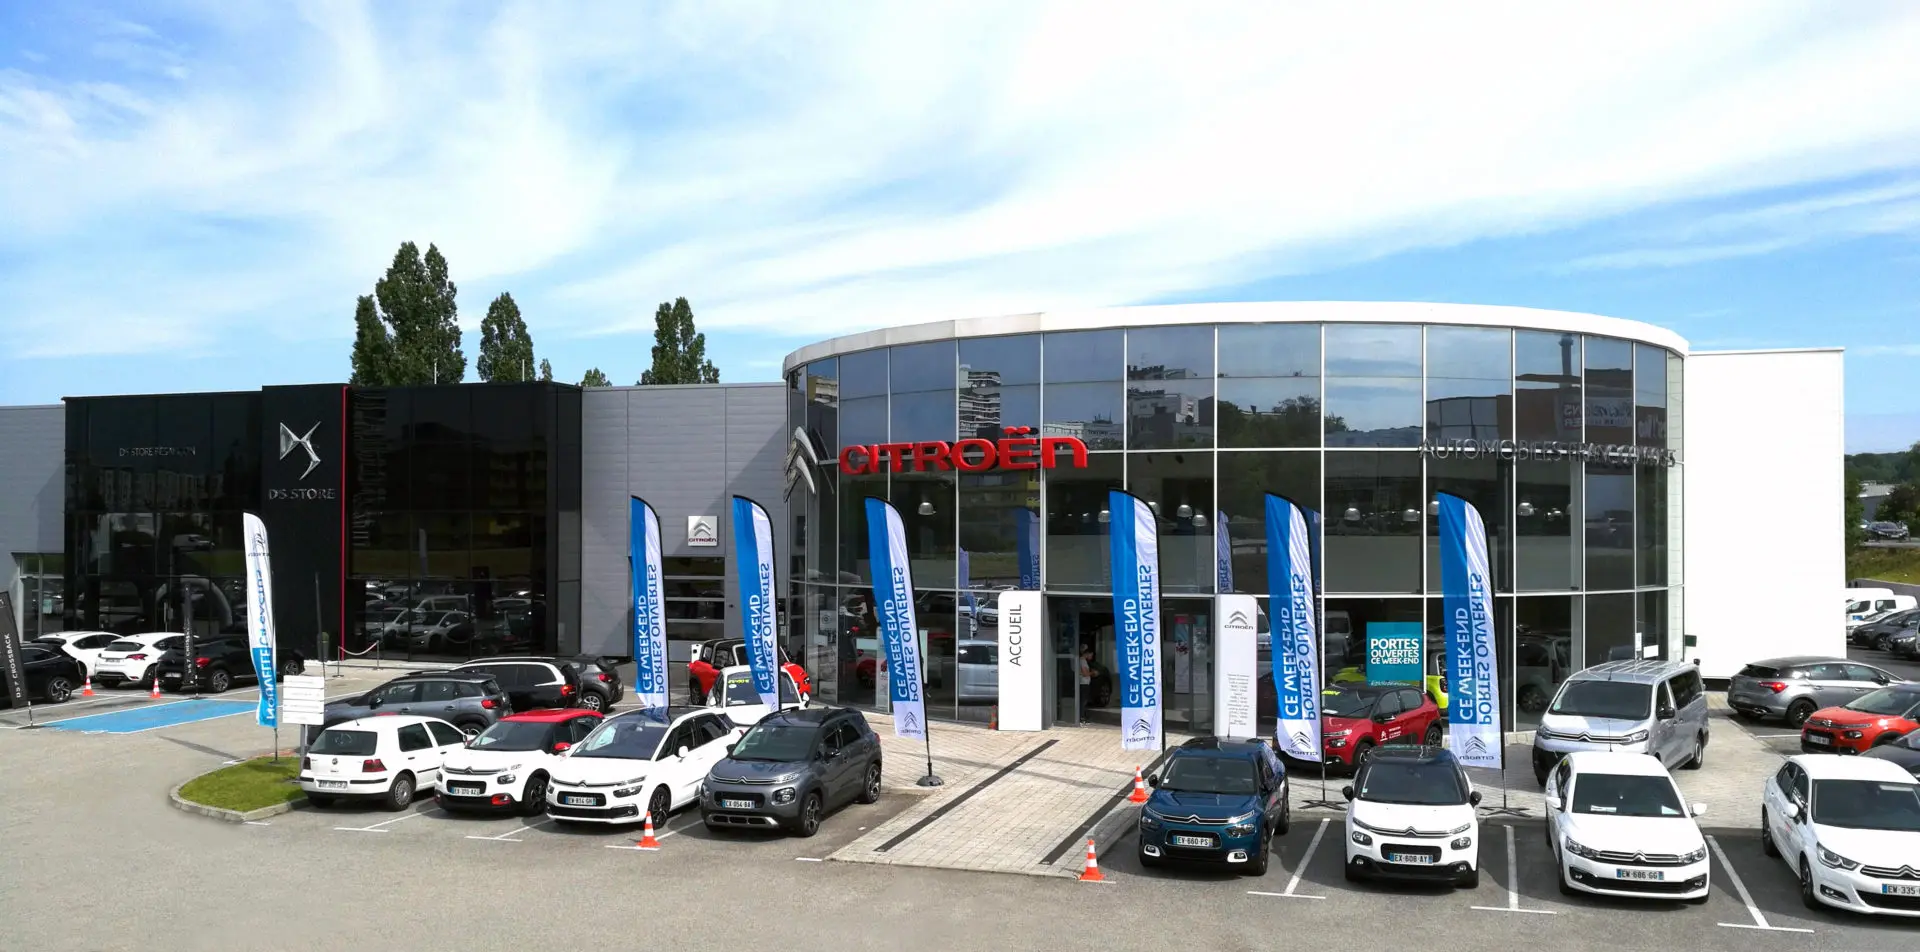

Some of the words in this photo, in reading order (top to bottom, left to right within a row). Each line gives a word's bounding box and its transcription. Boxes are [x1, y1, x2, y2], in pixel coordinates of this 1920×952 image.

[838, 425, 1089, 475] CITROËN
[1419, 438, 1561, 460] AUTOMOBILES
[269, 488, 287, 500] DS
[289, 488, 336, 500] STORE
[1009, 604, 1022, 667] ACCUEIL
[1370, 638, 1420, 650] PORTES
[4, 633, 18, 679] CROSSBACK
[1370, 650, 1420, 658] OUVERTES
